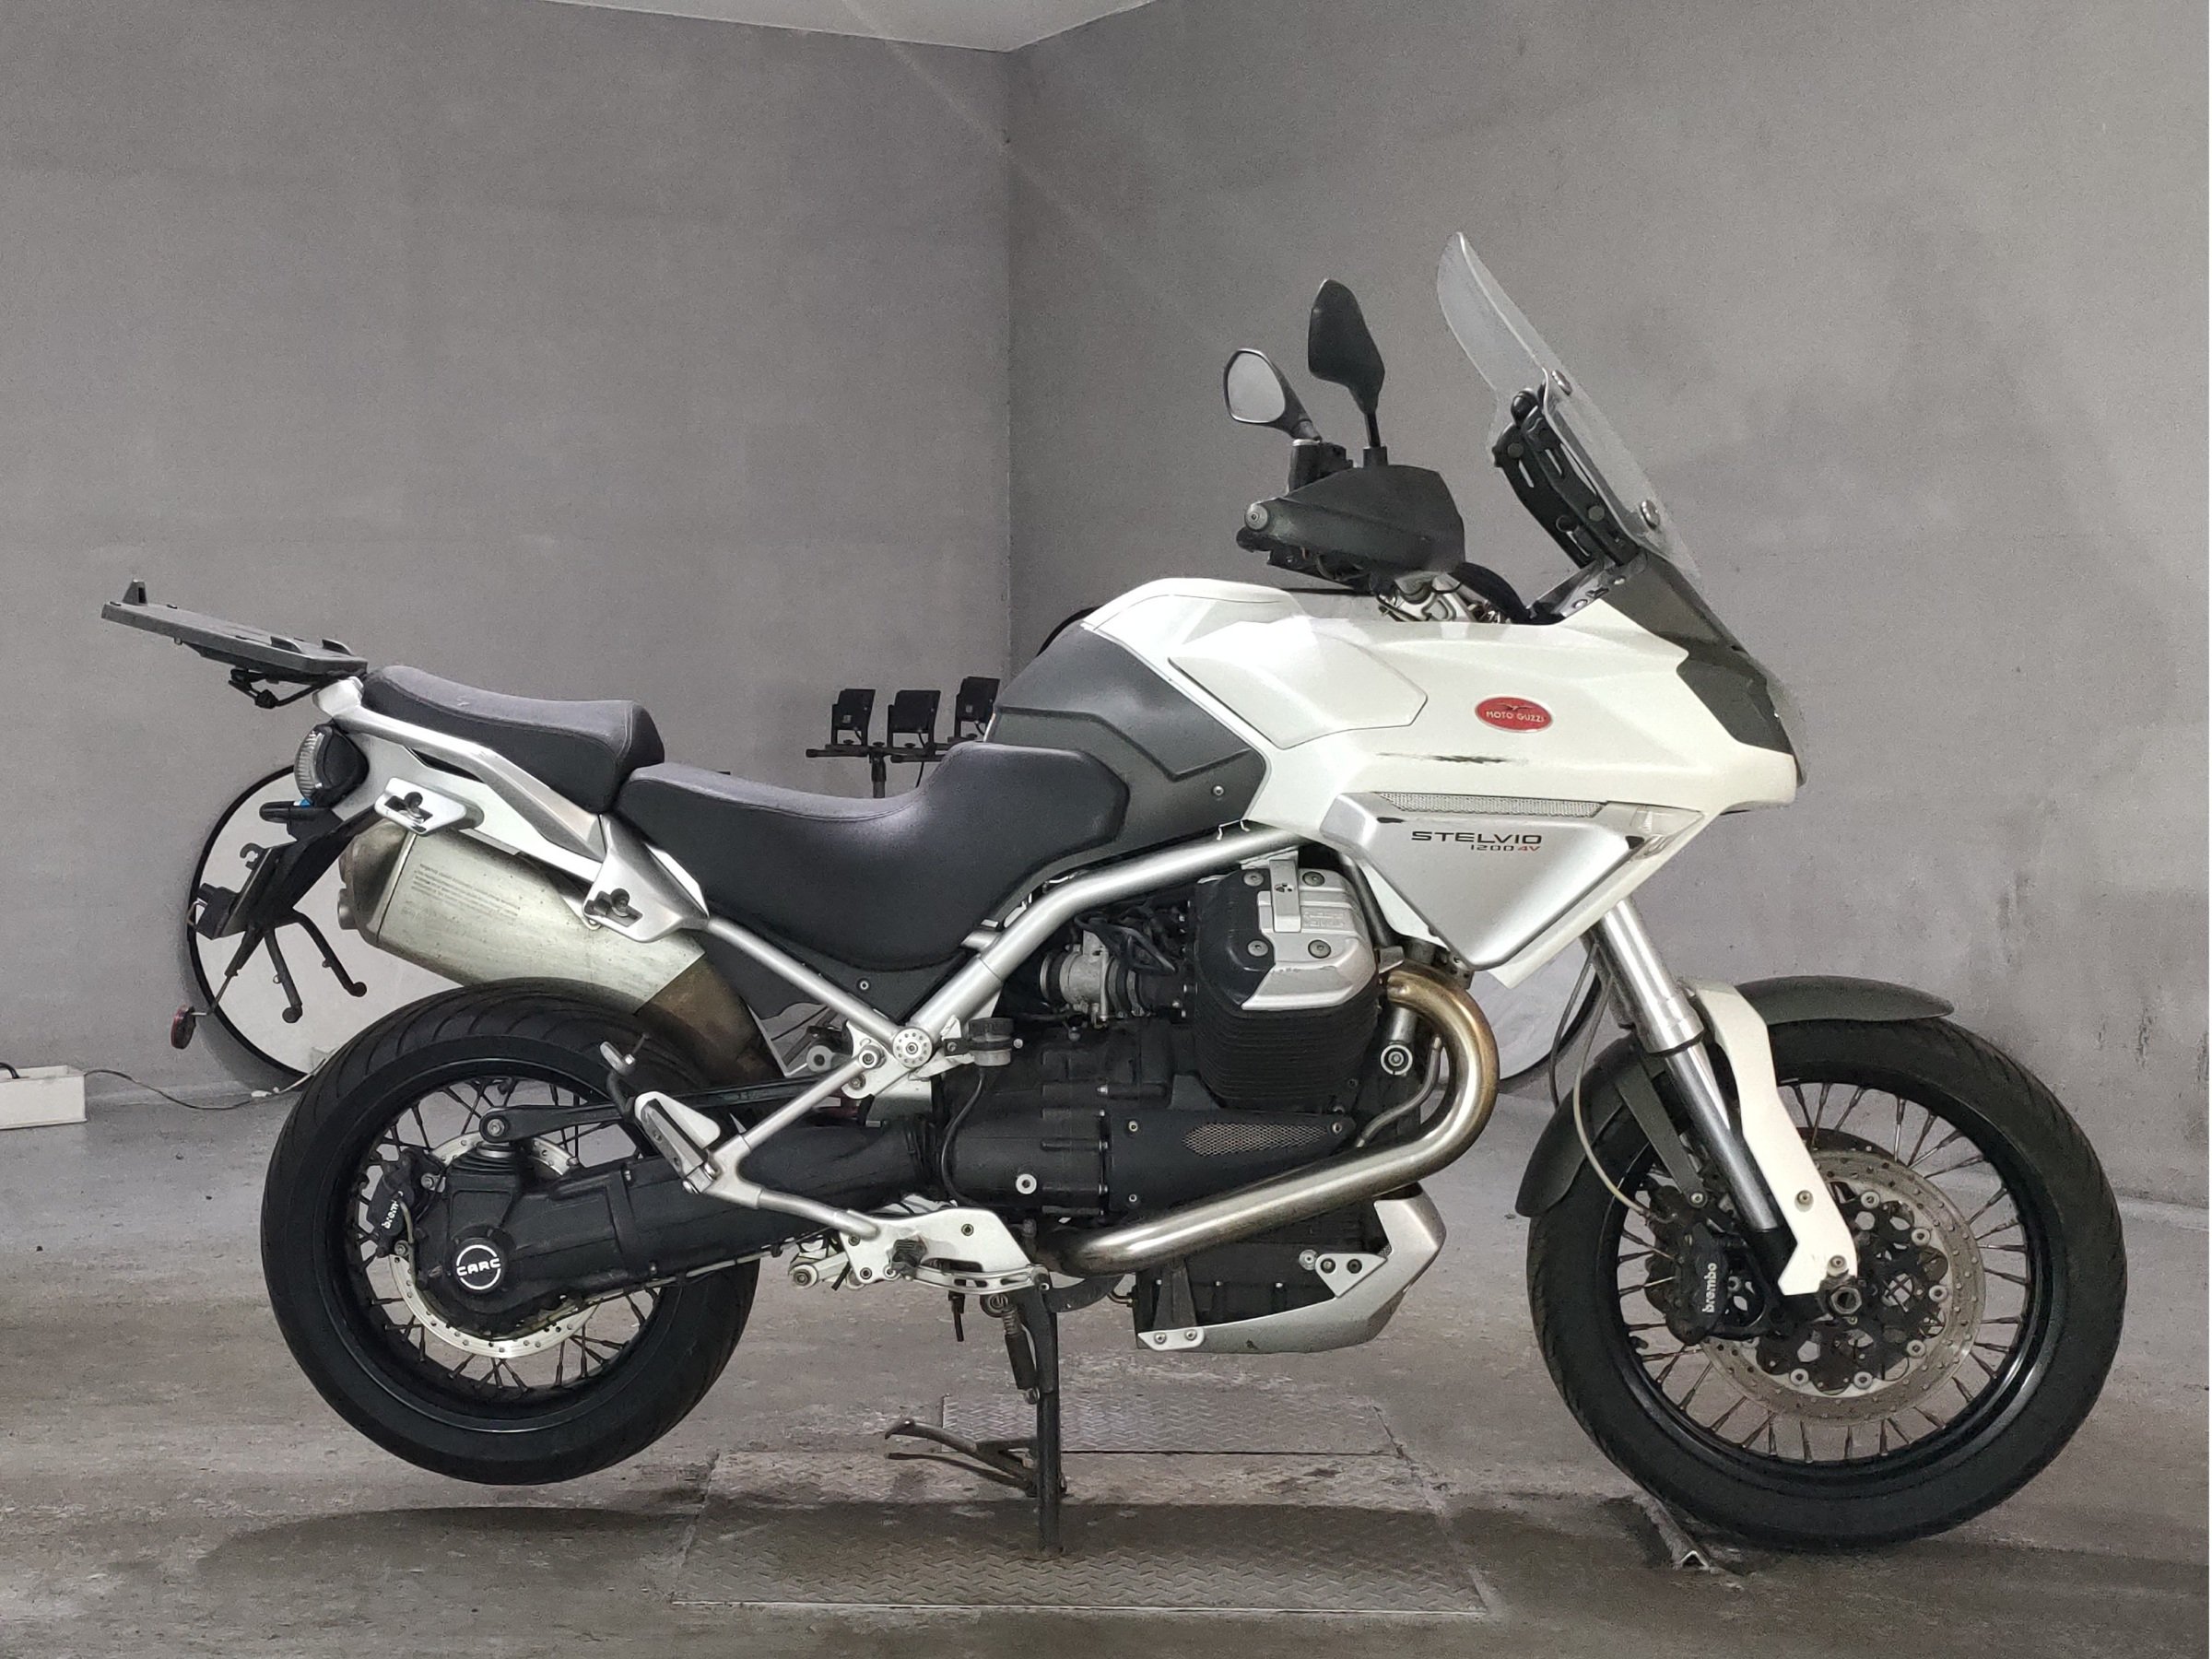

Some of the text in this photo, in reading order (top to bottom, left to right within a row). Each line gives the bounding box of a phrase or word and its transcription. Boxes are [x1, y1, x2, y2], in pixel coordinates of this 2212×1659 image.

[1486, 711, 1545, 723] MOTO GUZZI
[1411, 830, 1543, 844] STELVIO
[456, 1257, 501, 1277] CARC
[1701, 1263, 1717, 1312] brembo
